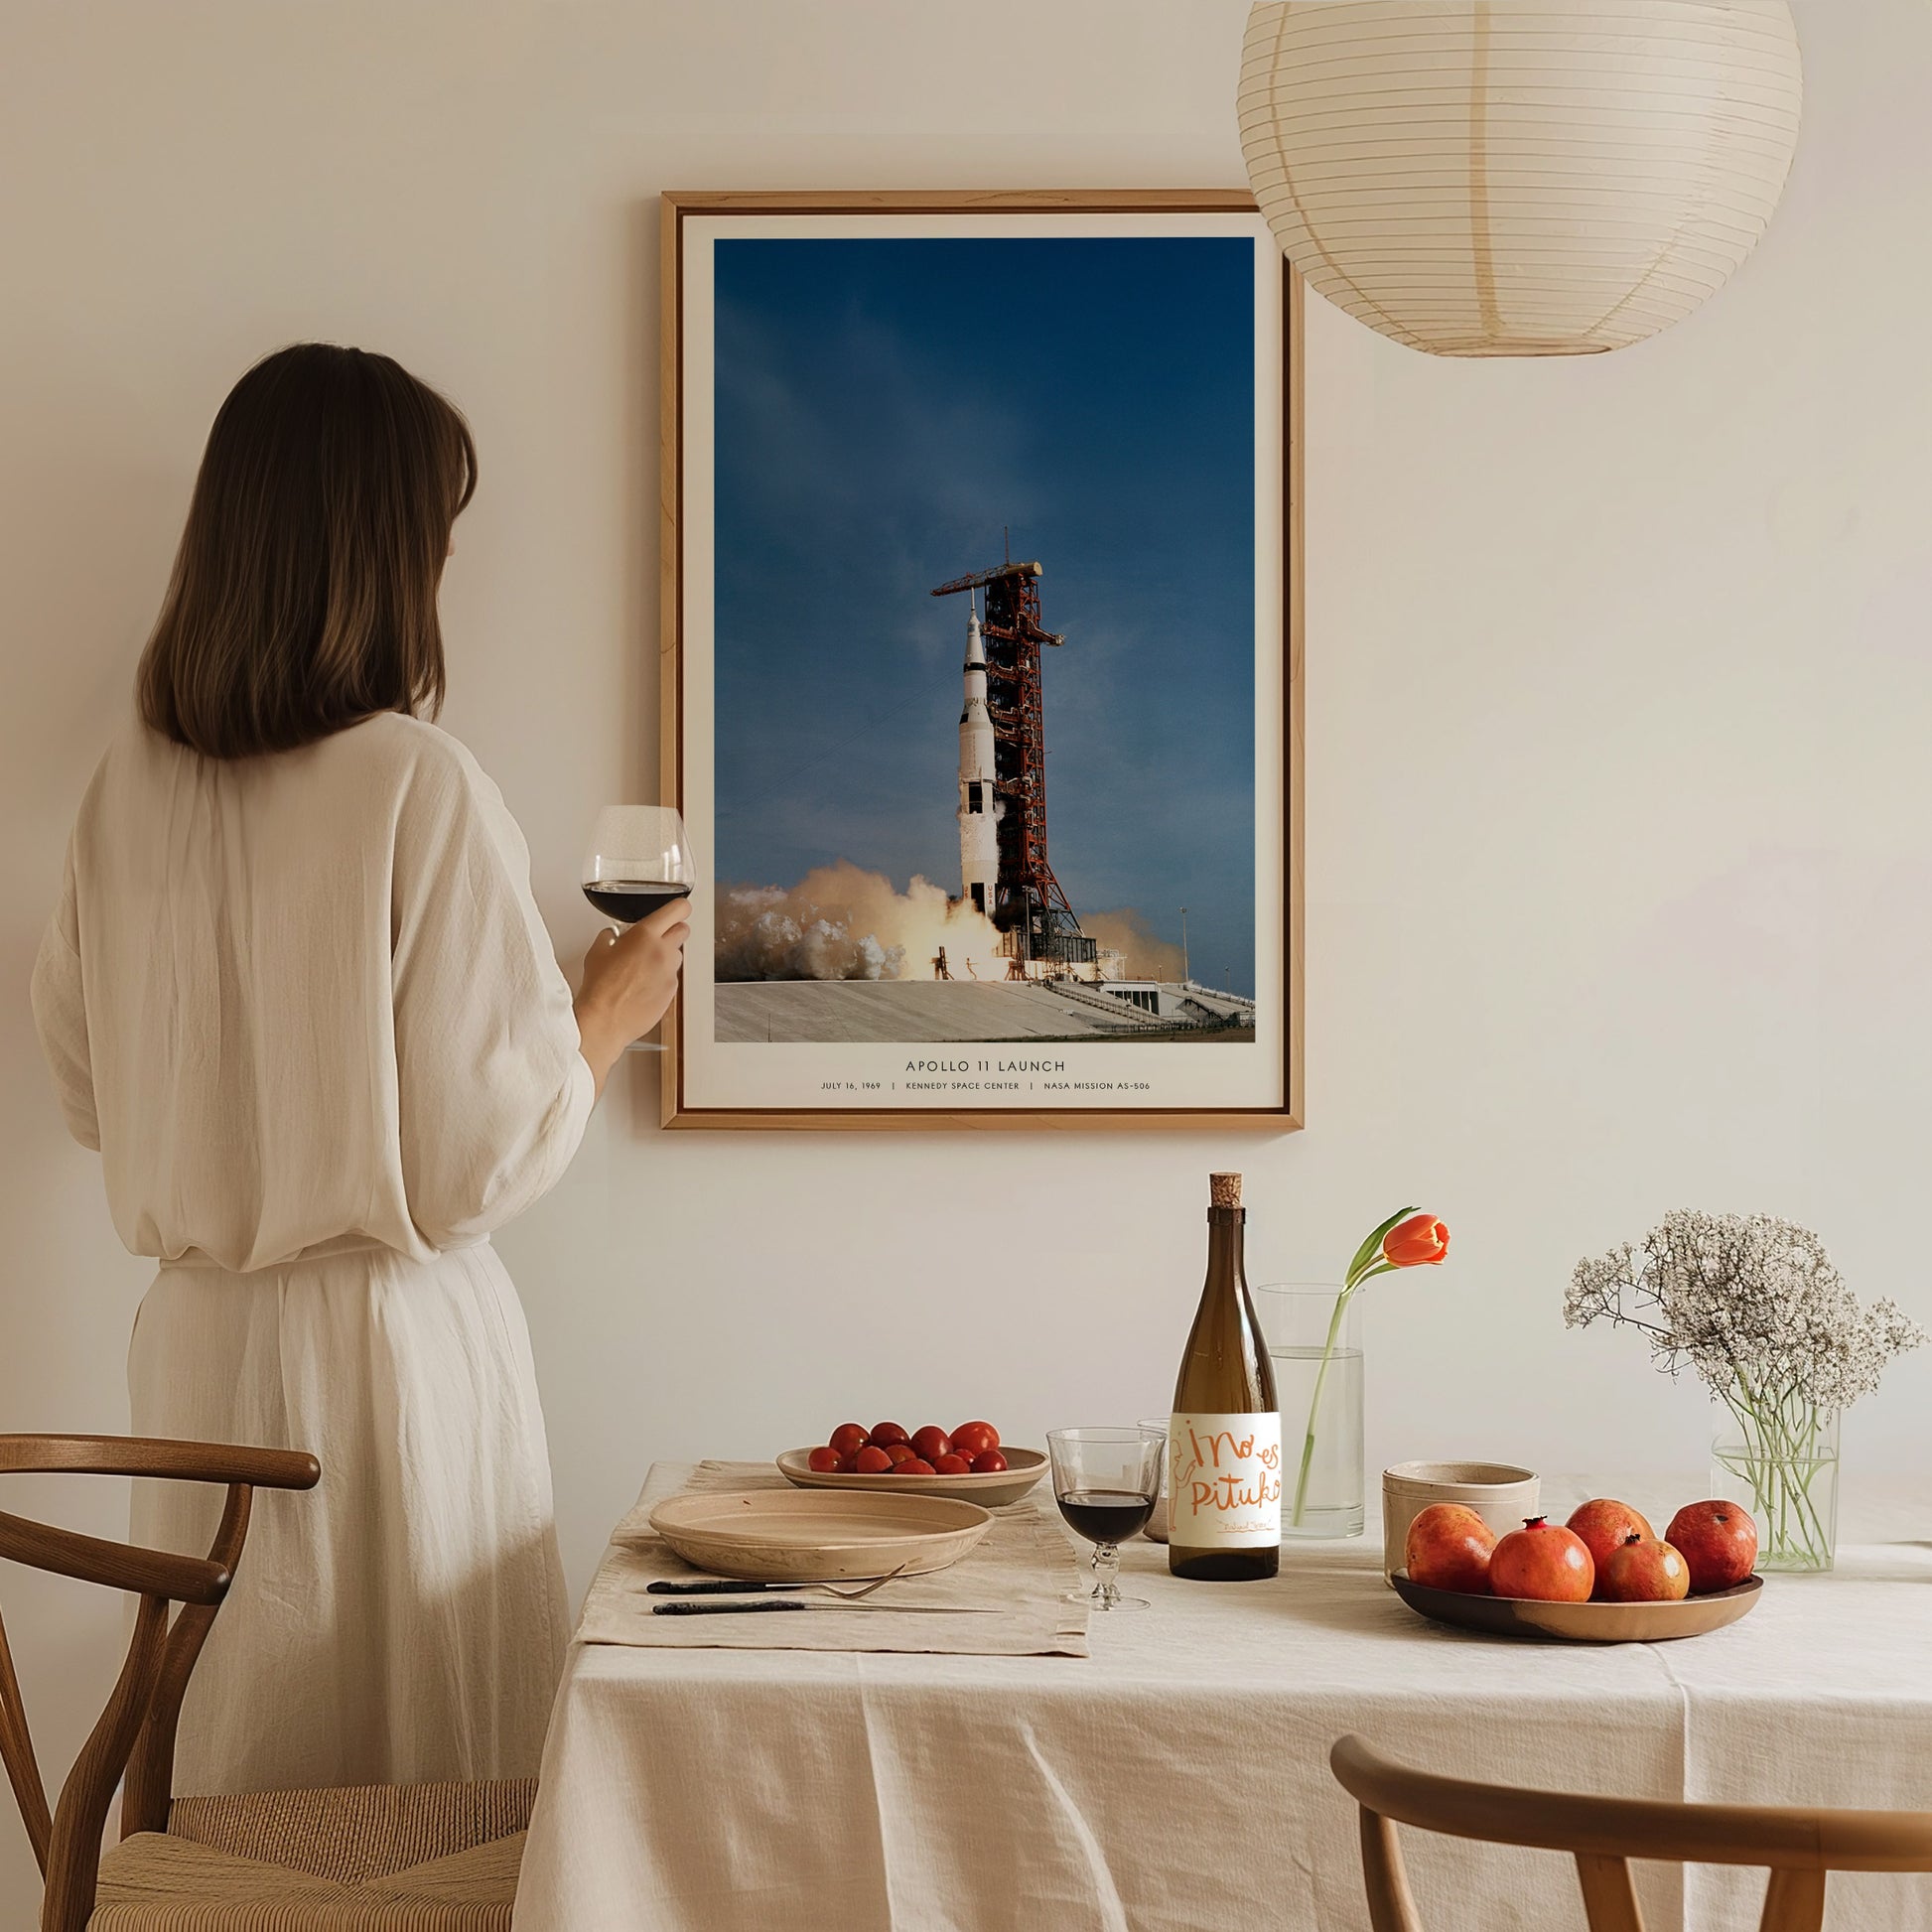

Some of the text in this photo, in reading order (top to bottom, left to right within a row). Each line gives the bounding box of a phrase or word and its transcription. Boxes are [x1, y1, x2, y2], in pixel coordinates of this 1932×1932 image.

[905, 1059, 1065, 1072] APOLLO 11 LAUNCH
[821, 1081, 882, 1092] JULY 16, 1969
[905, 1081, 1020, 1090] KENNEDY SPACE CENTER
[1043, 1081, 1151, 1090] NASA MISSION AS-506
[1256, 1444, 1280, 1470] es
